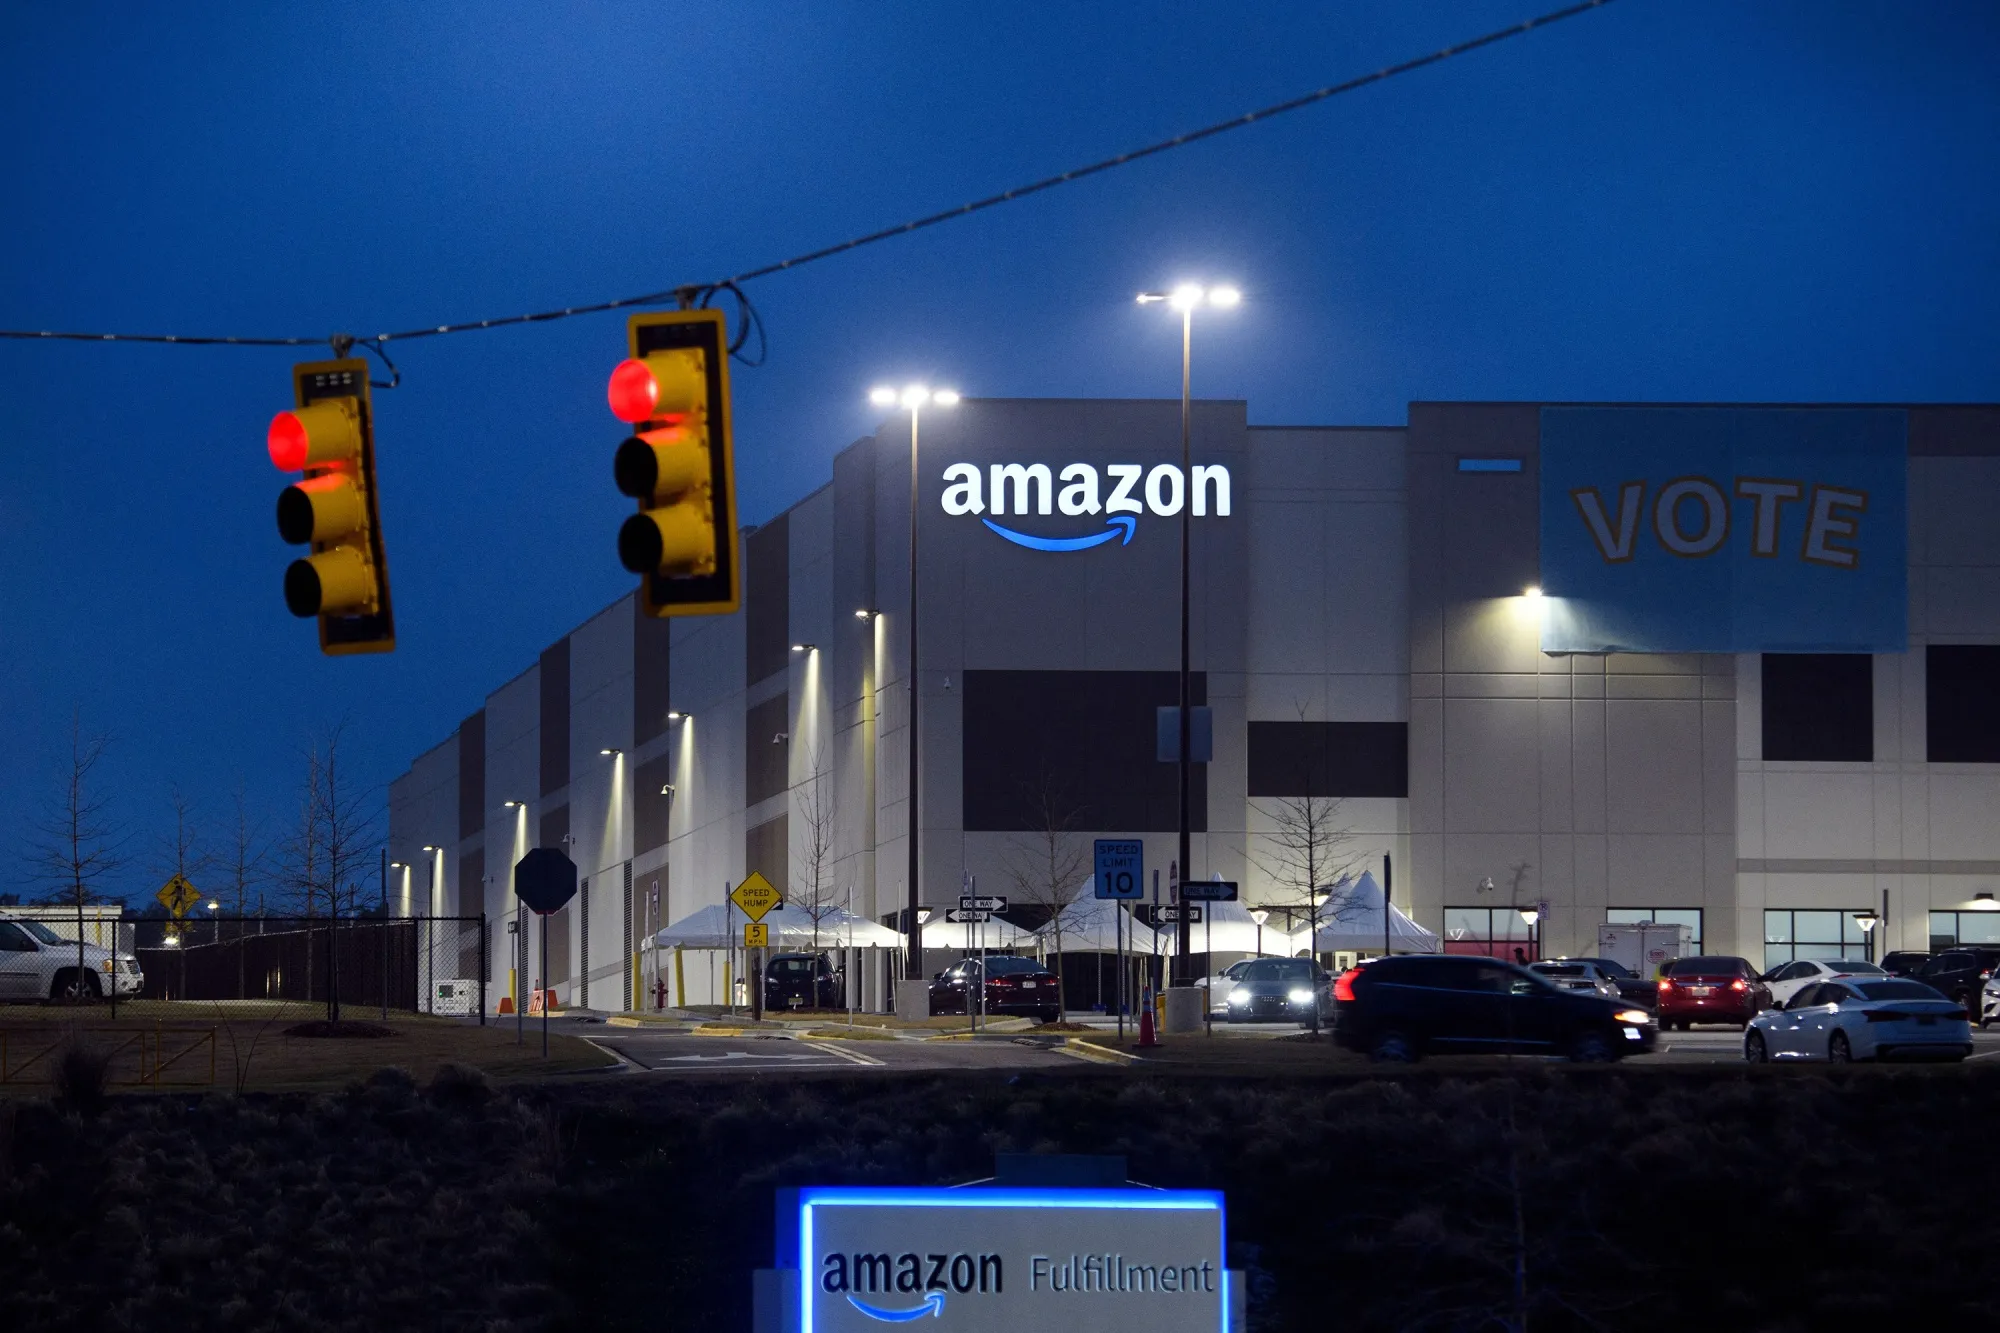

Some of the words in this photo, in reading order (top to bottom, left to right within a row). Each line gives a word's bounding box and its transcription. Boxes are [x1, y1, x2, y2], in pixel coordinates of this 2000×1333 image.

[941, 462, 1231, 517] amazon
[1570, 475, 1868, 571] VOTE
[1099, 845, 1137, 855] SPEED
[1103, 858, 1134, 867] LIMIT
[1105, 872, 1134, 894] 10
[743, 889, 770, 897] SPEED
[743, 899, 768, 907] HUMP
[752, 926, 761, 938] 5
[822, 1252, 1003, 1294] amazon
[1031, 1255, 1214, 1293] Fulfillment
